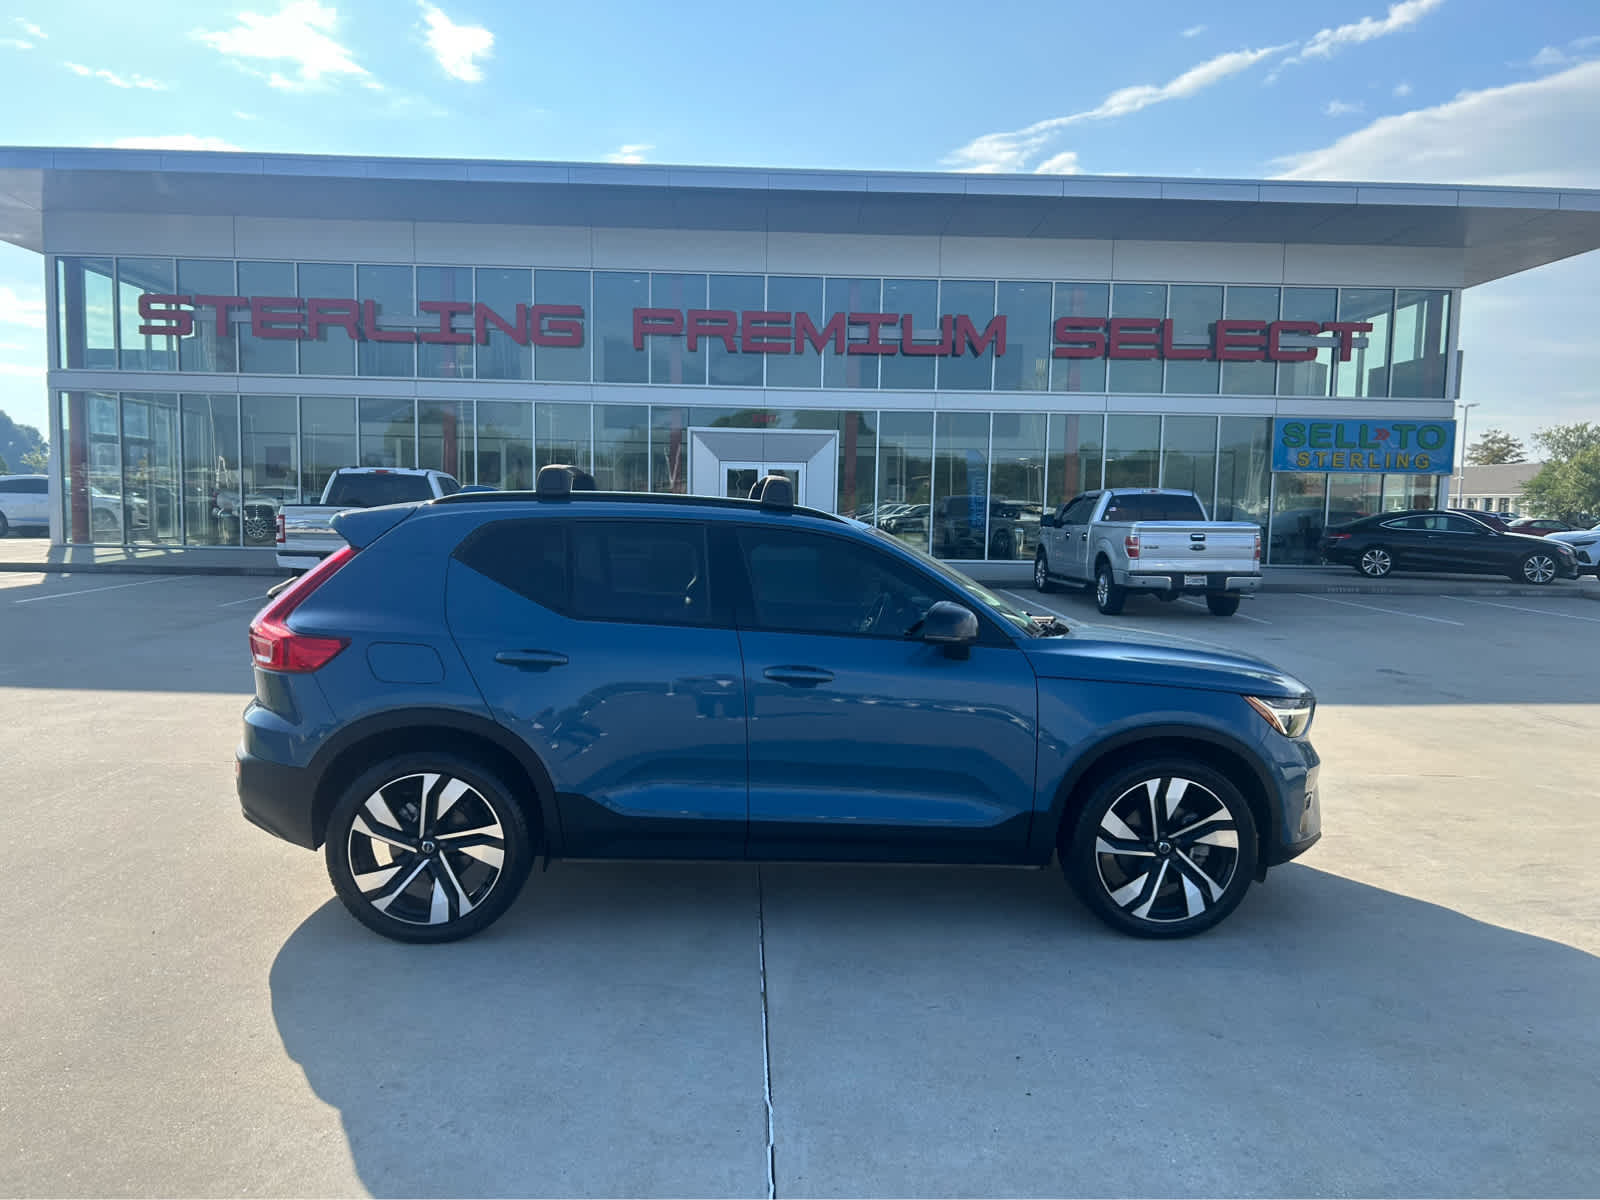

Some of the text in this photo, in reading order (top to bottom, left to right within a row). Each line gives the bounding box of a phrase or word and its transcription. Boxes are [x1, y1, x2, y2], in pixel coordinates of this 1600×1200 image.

[138, 293, 1374, 362] STERLING PREMIUM SELECT
[1282, 422, 1447, 450] SELL TO
[1297, 451, 1431, 469] STERLING
